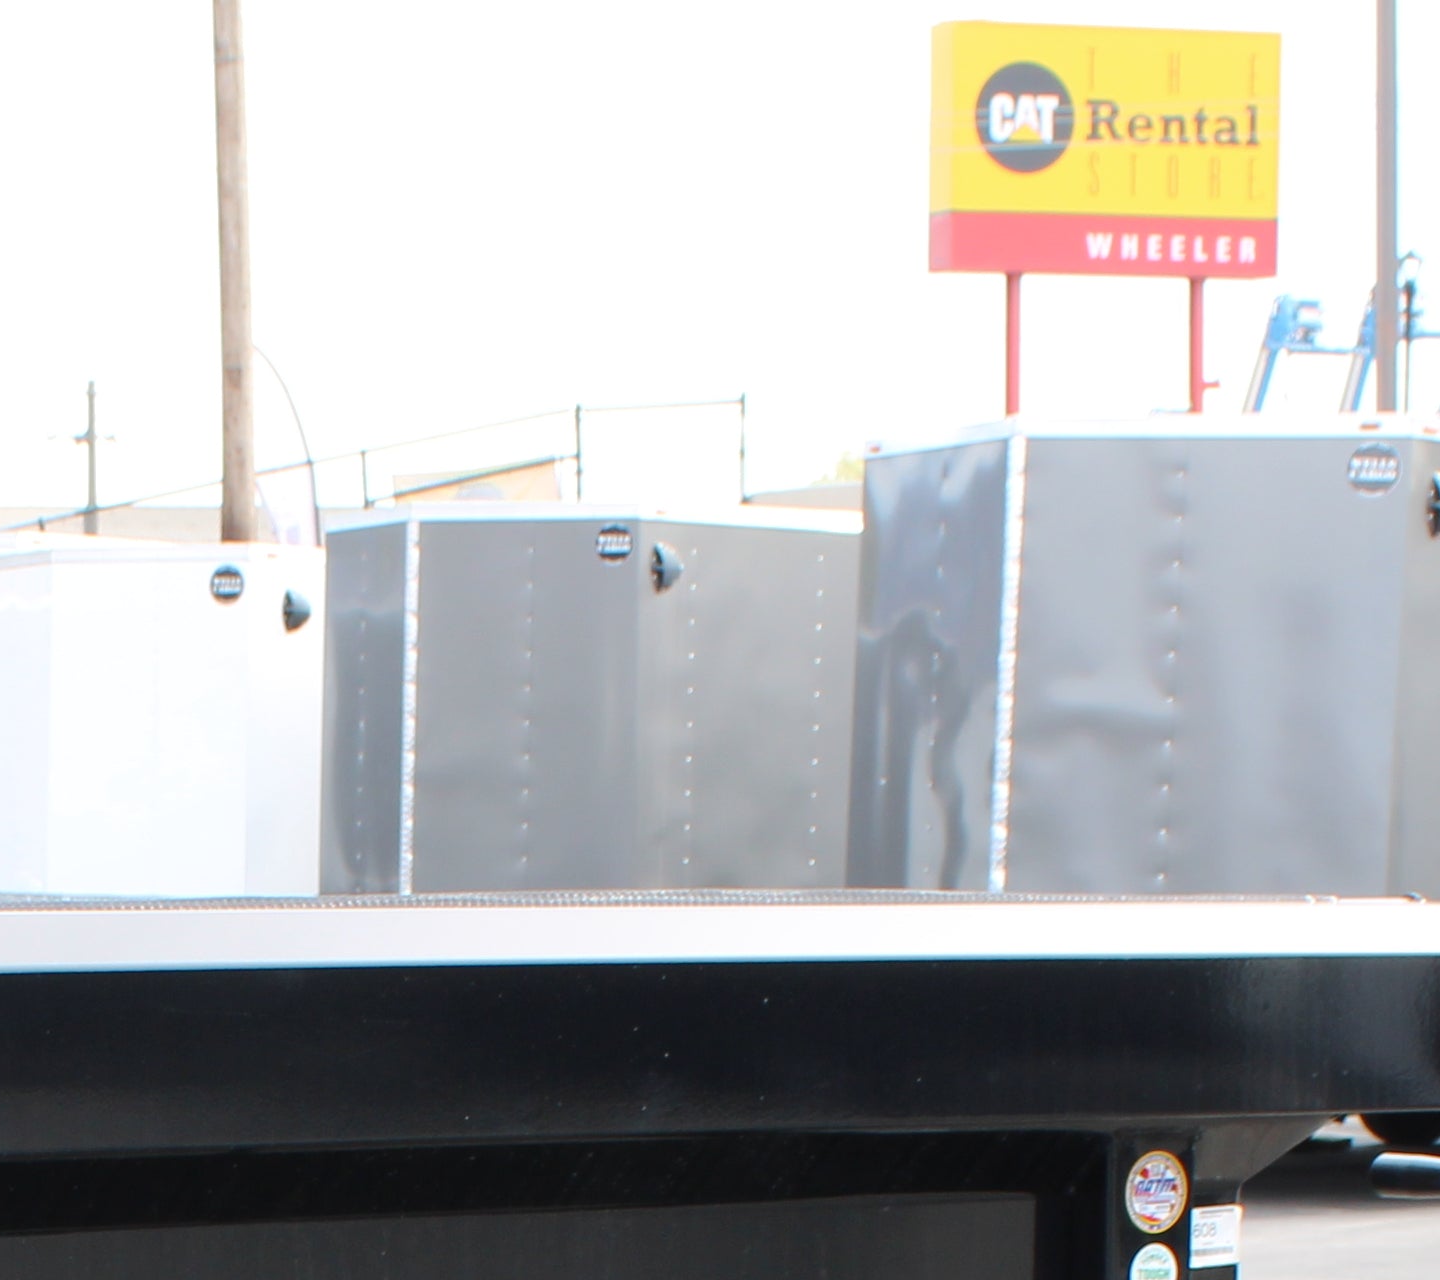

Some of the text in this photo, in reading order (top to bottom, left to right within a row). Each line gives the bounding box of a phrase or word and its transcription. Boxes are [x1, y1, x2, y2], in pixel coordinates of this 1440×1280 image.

[1087, 46, 1259, 98] THE
[988, 92, 1262, 147] CAT Rental
[1087, 150, 1259, 201] STORE
[1085, 231, 1258, 264] WHEELER
